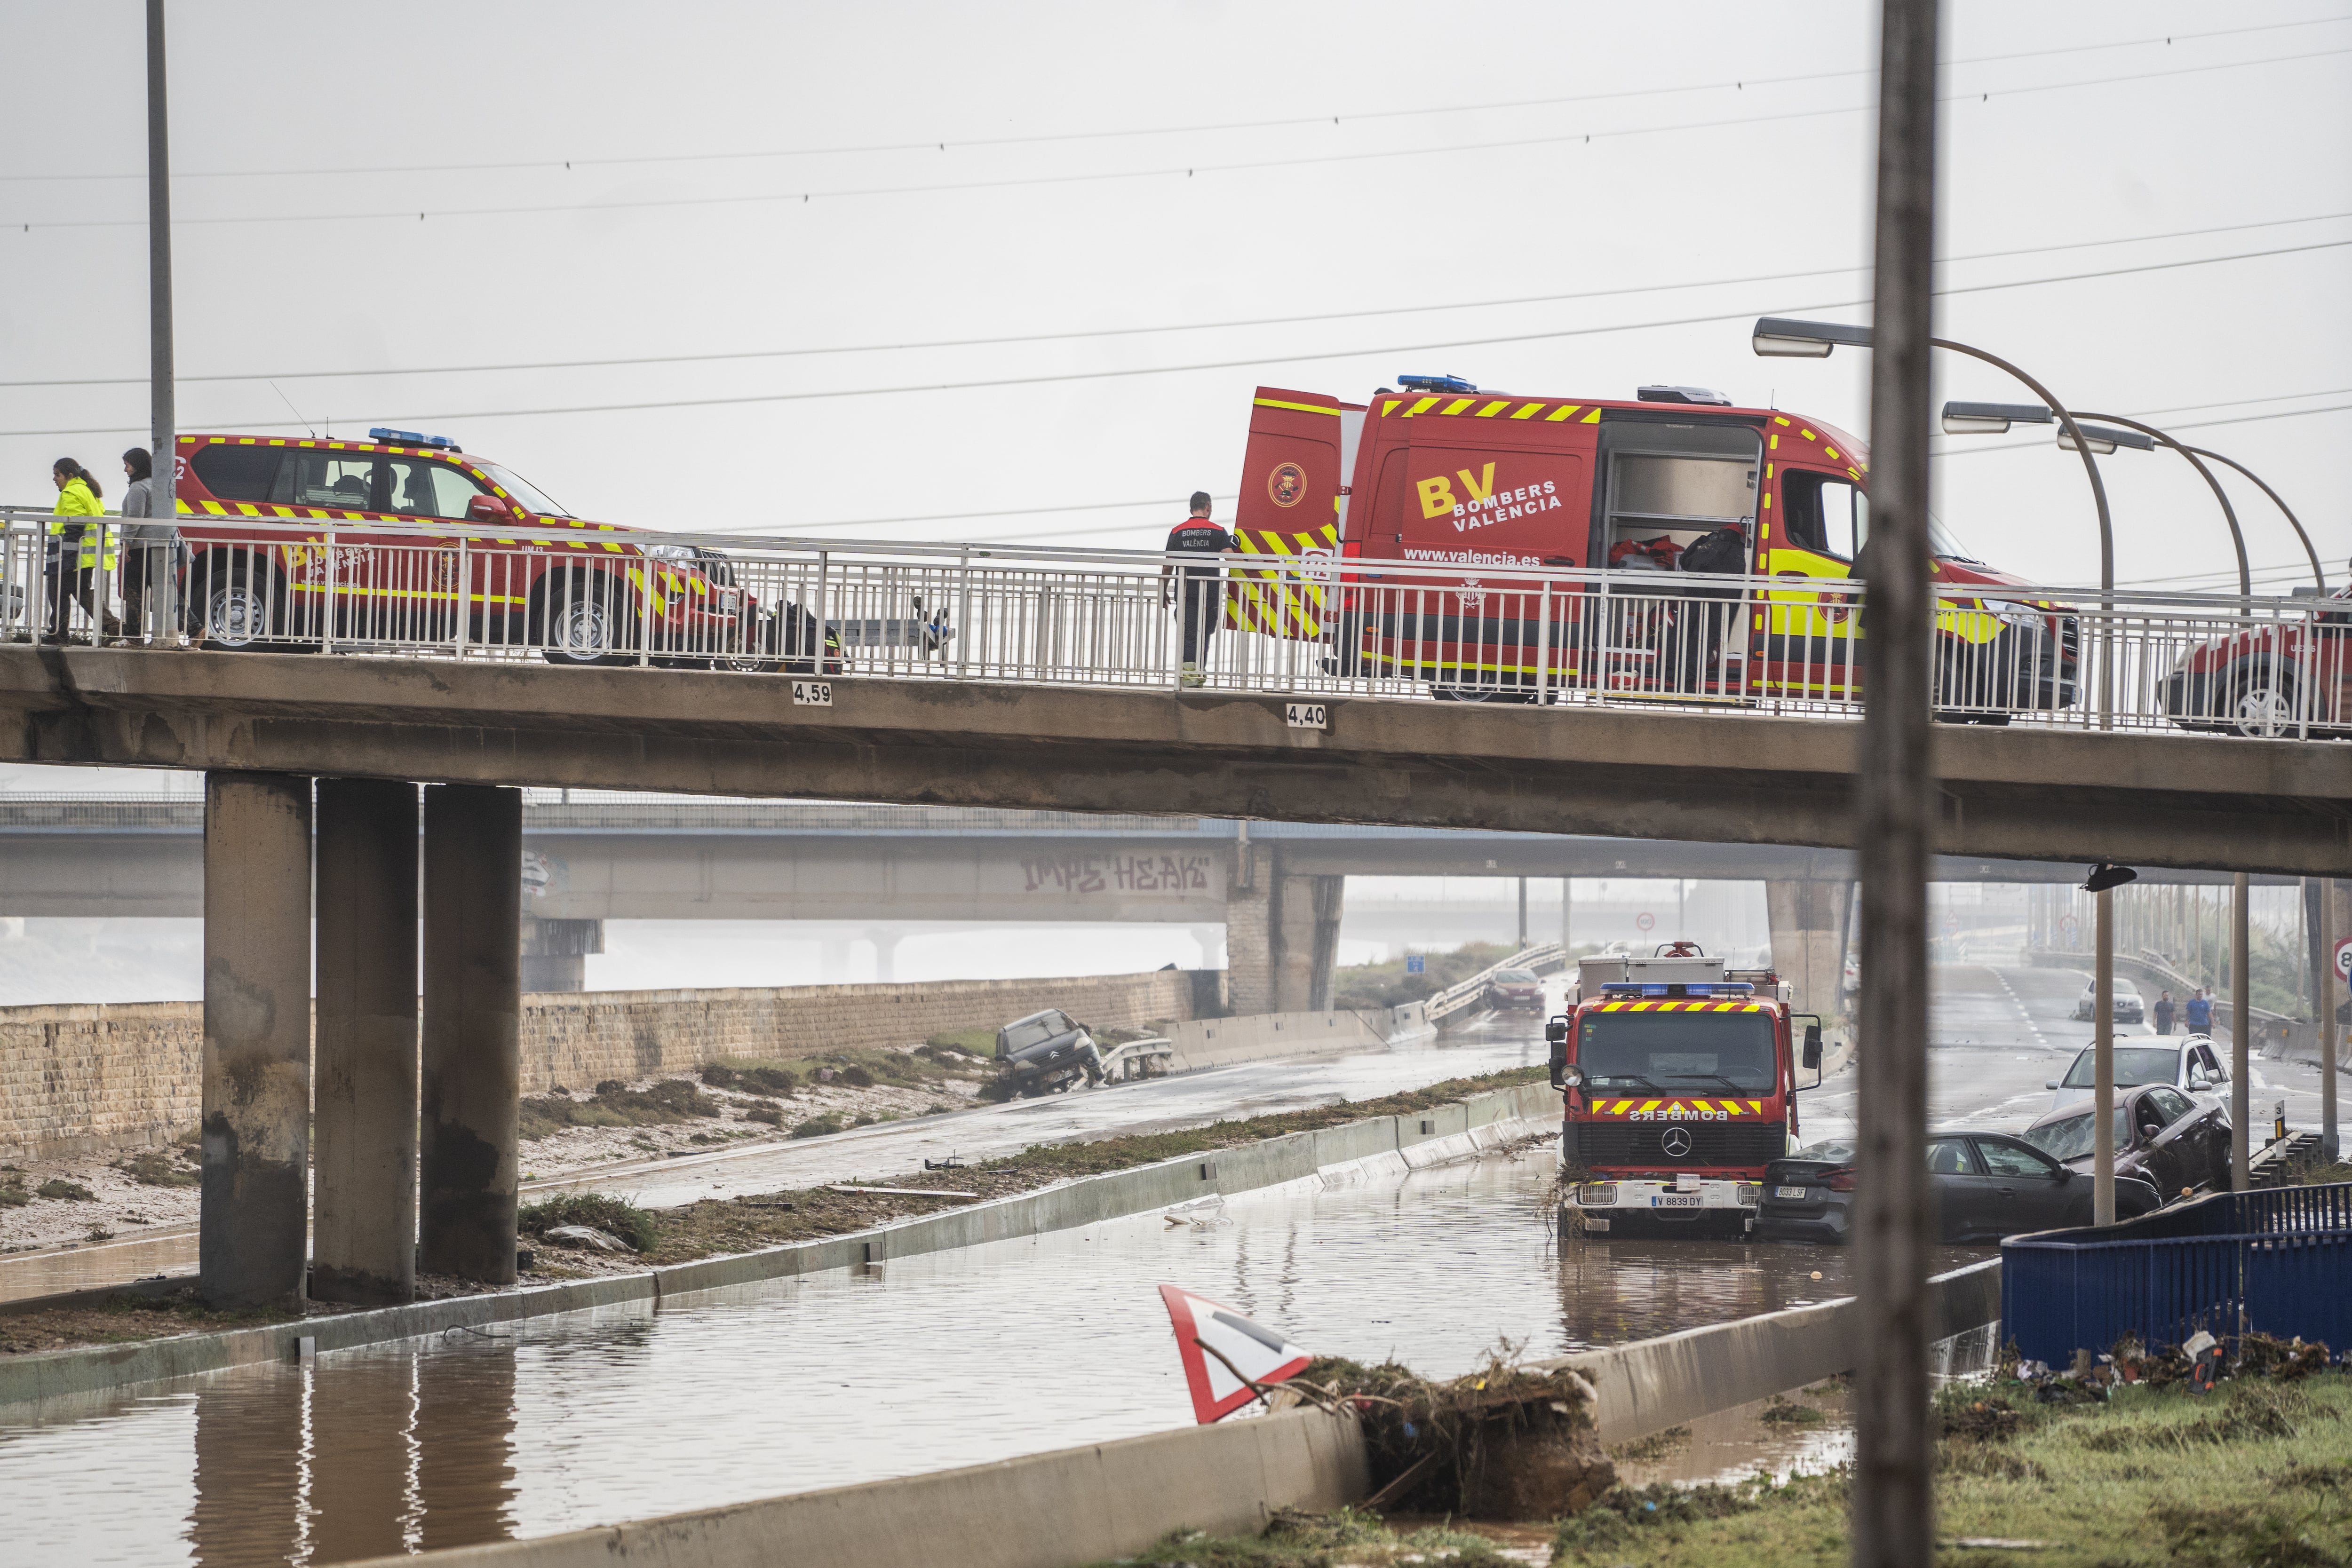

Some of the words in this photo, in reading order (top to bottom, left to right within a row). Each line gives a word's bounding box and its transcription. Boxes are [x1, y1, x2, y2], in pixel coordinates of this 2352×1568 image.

[1453, 481, 1556, 517] BOMBERS
[1453, 495, 1562, 532] VALÈNCIA
[1183, 539, 1209, 547] VALÈNCIA
[1404, 549, 1540, 566] www.valencia.es
[795, 684, 830, 704] 4,59
[1288, 706, 1325, 725] 4,40
[1658, 1197, 1663, 1206] V
[1667, 1197, 1687, 1206] 8839
[1690, 1197, 1700, 1206] DY
[1779, 1188, 1792, 1196] 8033
[1793, 1188, 1804, 1197] LSF
